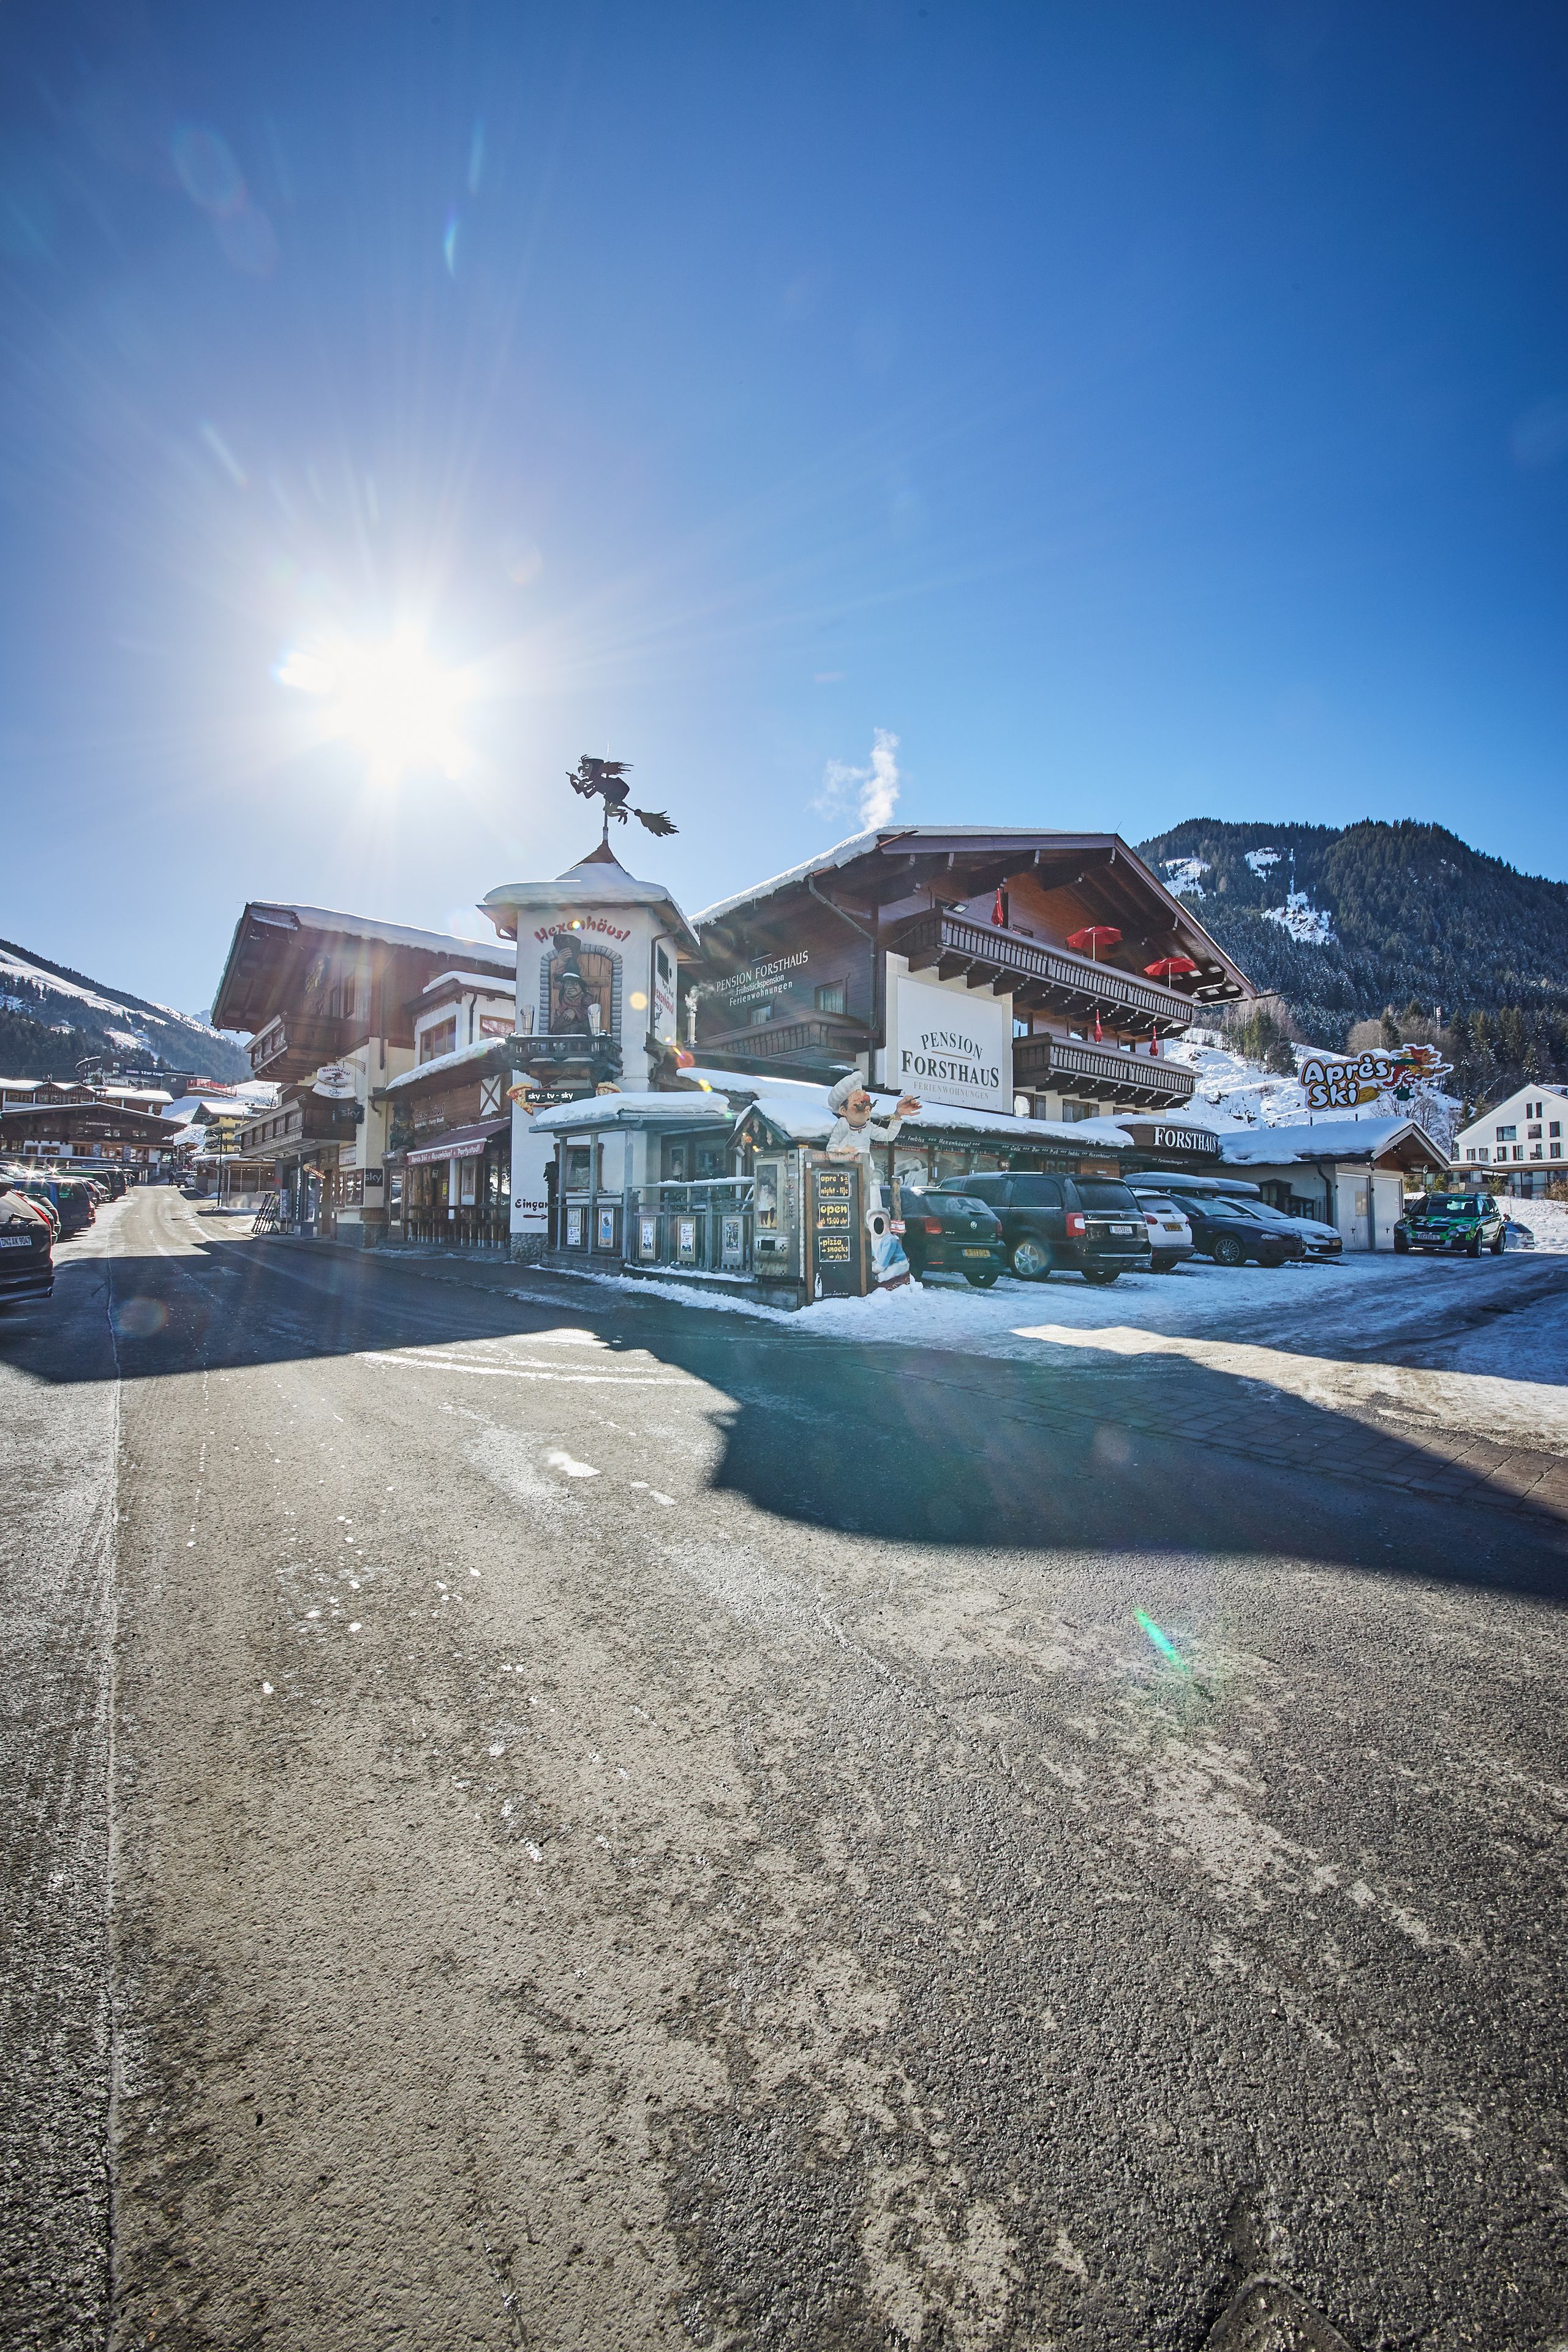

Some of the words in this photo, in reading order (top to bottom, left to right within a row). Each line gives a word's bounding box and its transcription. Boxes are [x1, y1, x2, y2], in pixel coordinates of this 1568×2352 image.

[717, 970, 752, 992] PENSION
[755, 950, 809, 979] FORSTHAUS
[729, 981, 793, 1006] Ferienwohnungen
[736, 974, 785, 996] Frühstückspension
[920, 1031, 983, 1060] PENSION
[901, 1050, 999, 1088] FORSTHAUS
[1303, 1054, 1390, 1086] Après
[528, 1092, 540, 1101] sky
[913, 1081, 989, 1100] FERIENWOHNUNGEN
[1310, 1081, 1358, 1107] Ski
[1153, 1126, 1216, 1153] FORSTHAUS
[365, 1172, 382, 1183] sky
[821, 1187, 835, 1196] night
[840, 1187, 848, 1196] life
[821, 1205, 847, 1216] open
[823, 1238, 842, 1247] pizza
[827, 1244, 848, 1253] snacks
